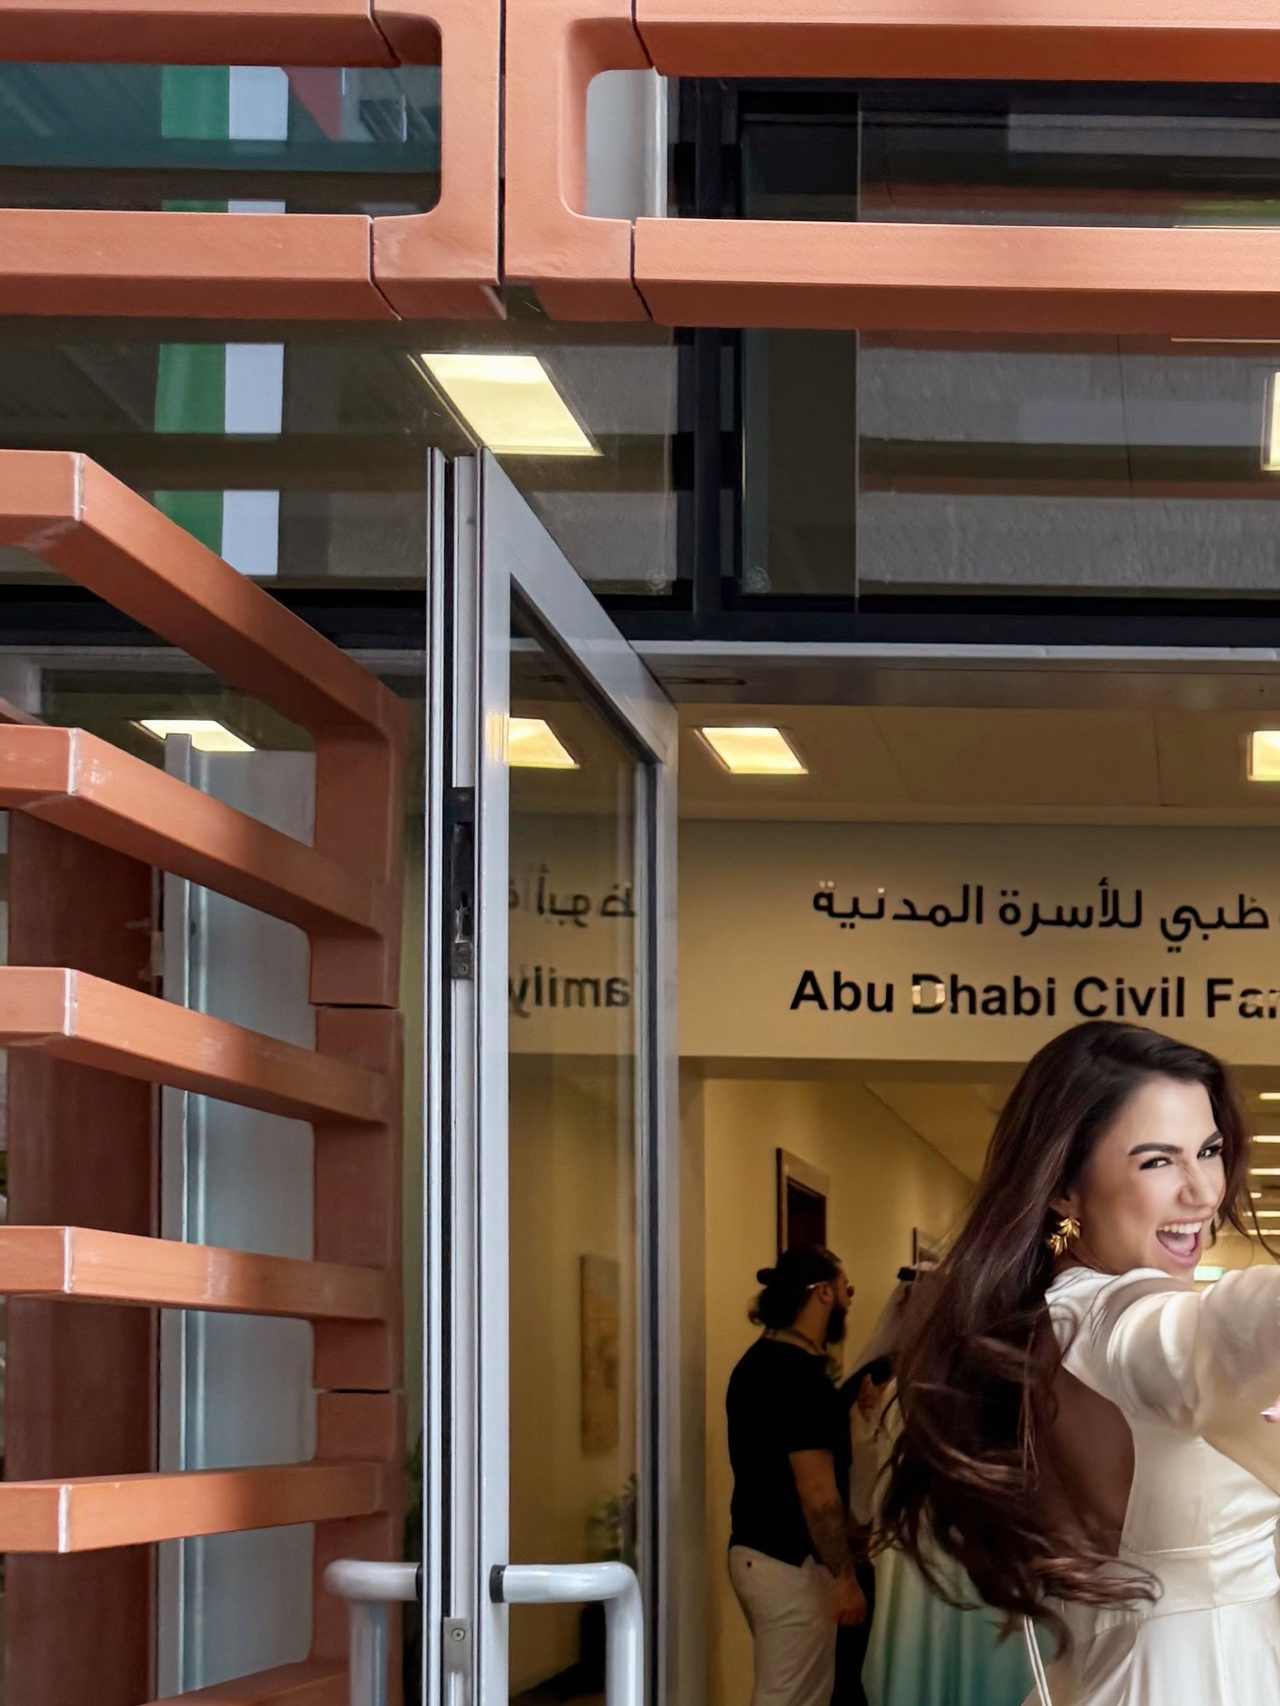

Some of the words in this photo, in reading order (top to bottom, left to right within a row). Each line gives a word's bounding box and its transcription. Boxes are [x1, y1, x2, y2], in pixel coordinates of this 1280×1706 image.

[812, 880, 984, 930] المدنية
[998, 876, 1143, 937] للأسرة
[790, 970, 894, 1013] Abu
[912, 974, 1056, 1016] Dhabi
[1073, 976, 1185, 1018] Civil
